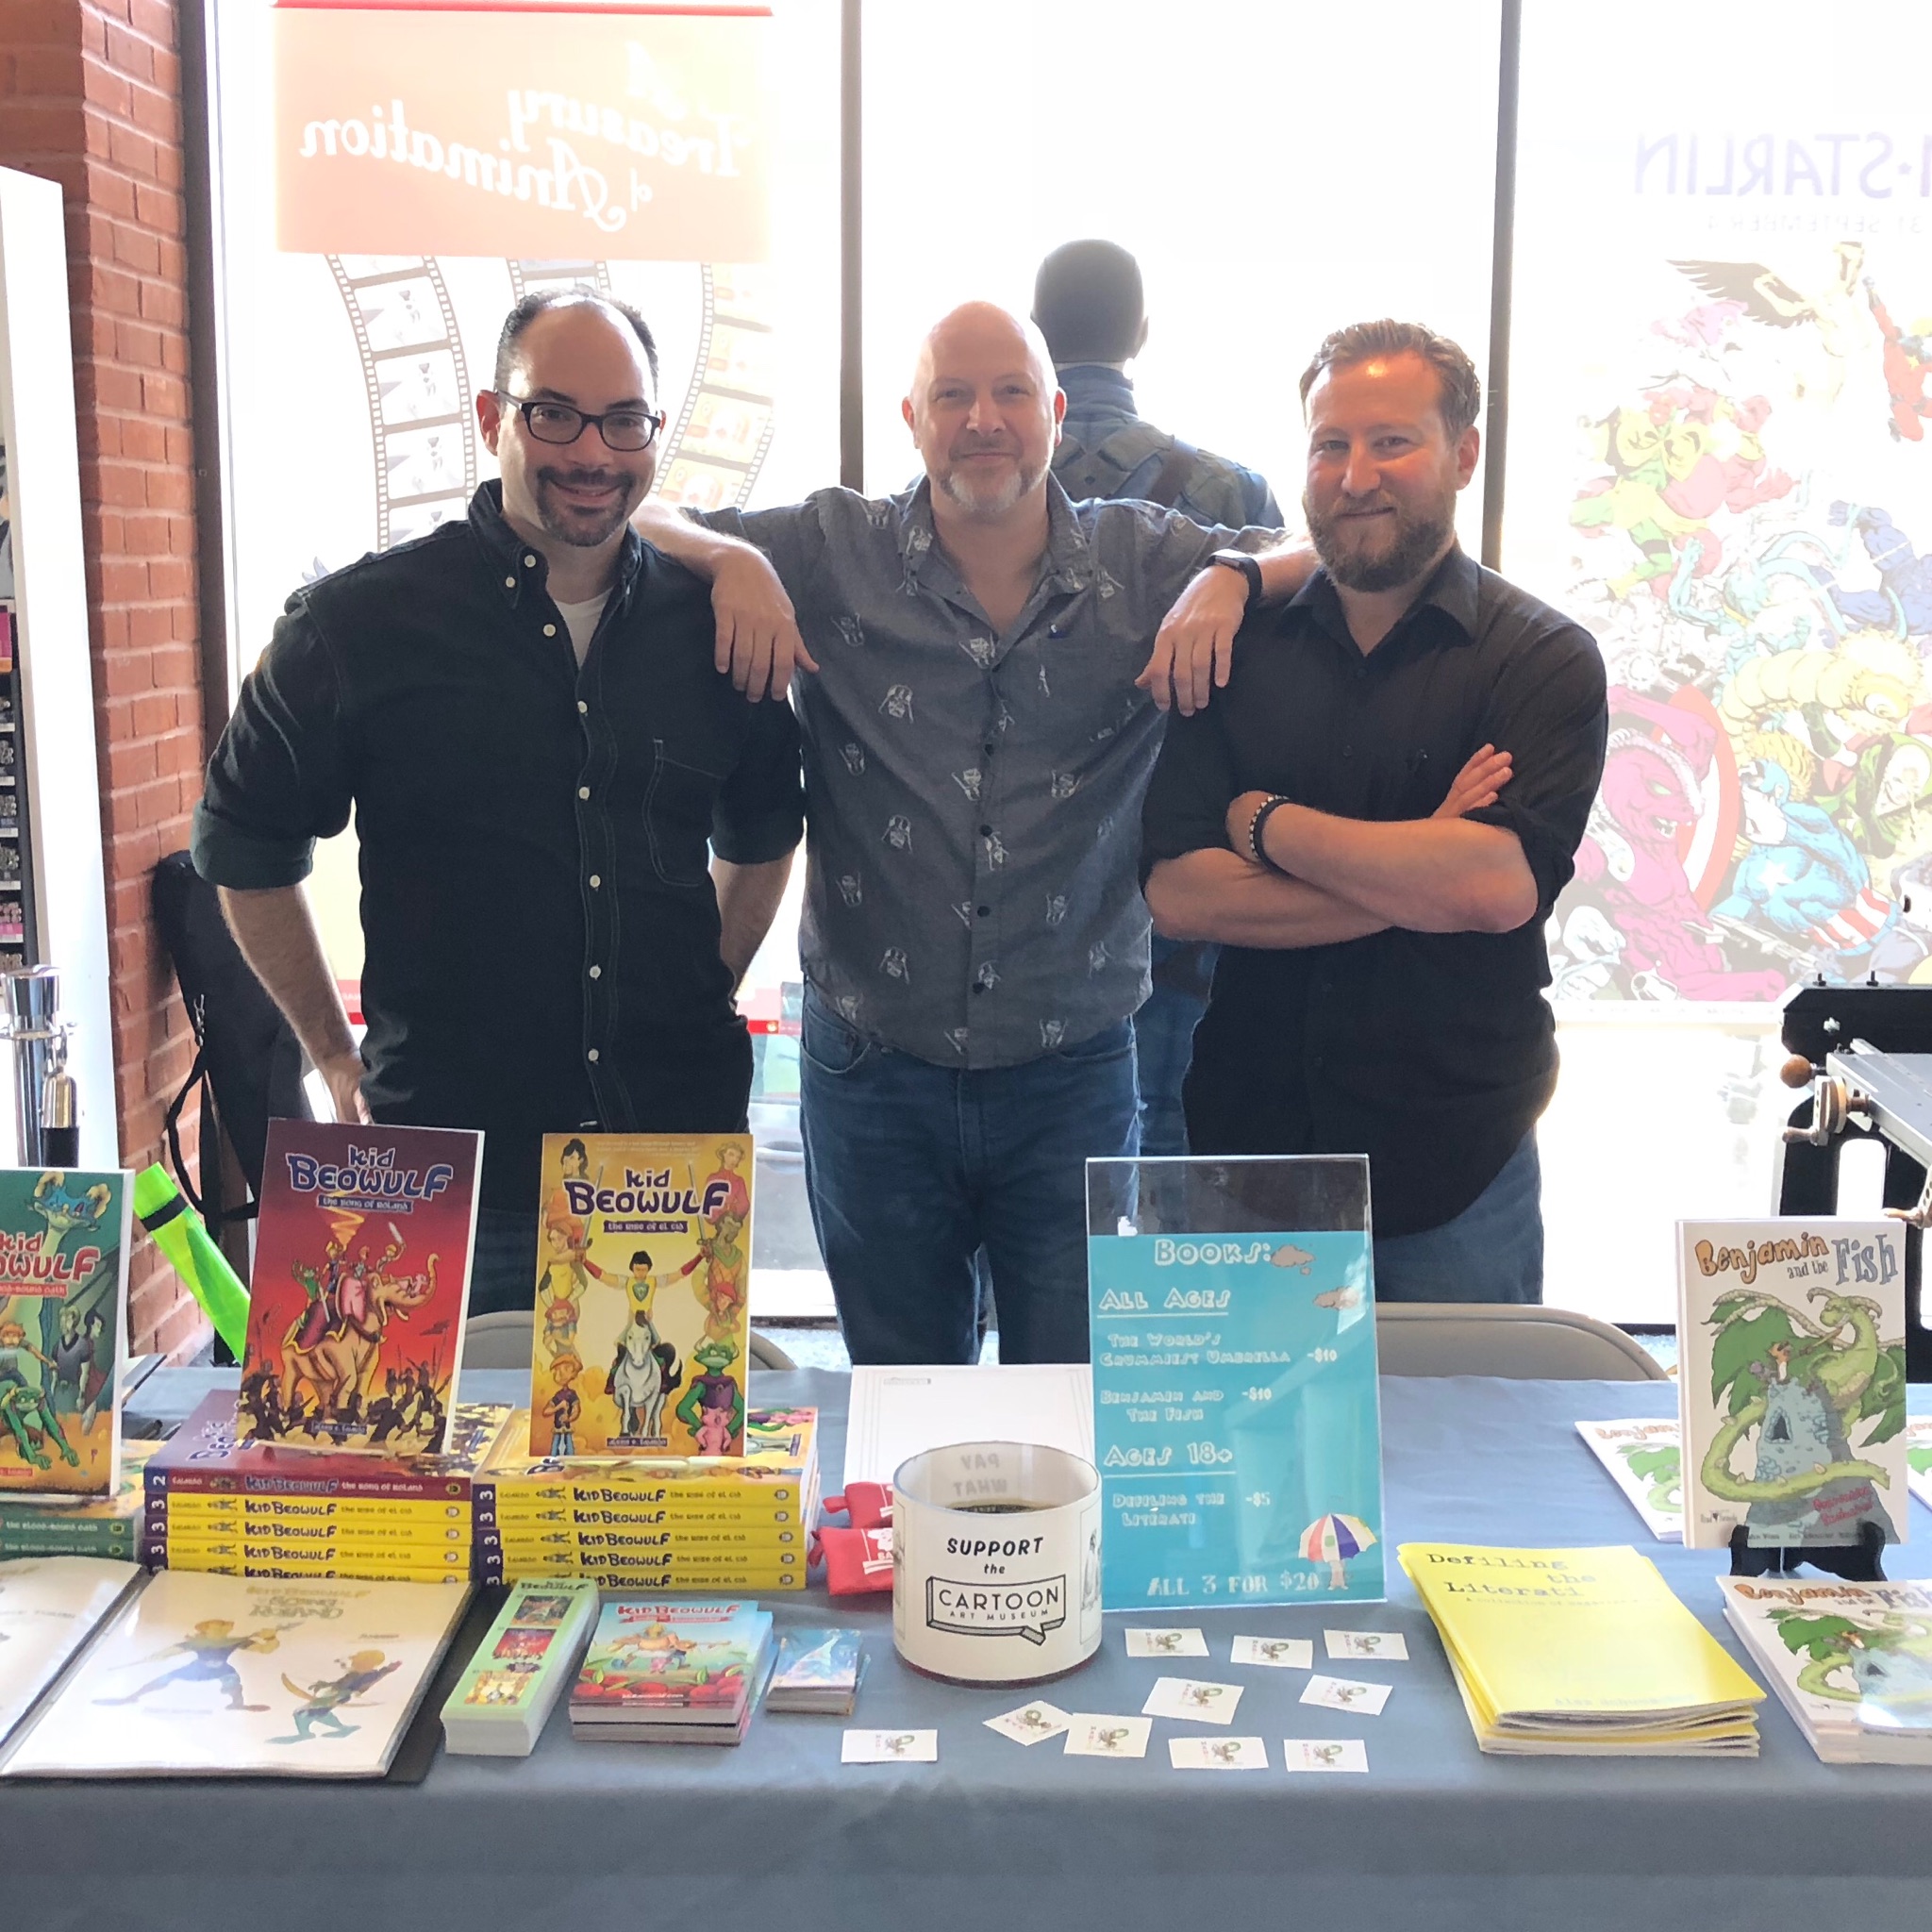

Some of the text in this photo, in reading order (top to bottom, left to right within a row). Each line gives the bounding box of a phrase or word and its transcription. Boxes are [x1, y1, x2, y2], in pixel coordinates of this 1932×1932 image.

[286, 1152, 454, 1202] BEOWULF
[564, 1180, 730, 1216] BEOWULF
[1694, 1231, 1898, 1286] Benjamin and the Fish
[1187, 1441, 1233, 1465] 18+
[153, 1475, 166, 1486] 2
[479, 1491, 493, 1500] 3
[600, 1489, 666, 1502] BEOWULF
[152, 1499, 165, 1508] 3
[272, 1501, 337, 1515] BEOWULF
[479, 1512, 493, 1522] 3
[600, 1510, 666, 1524] BEOWULF
[152, 1523, 165, 1532] 3
[272, 1524, 337, 1538] BEOWULF
[484, 1535, 498, 1545] 3
[605, 1533, 671, 1546] BEOWULF
[946, 1536, 1043, 1557] SUPPORT
[151, 1545, 164, 1555] 3
[271, 1546, 336, 1560] BEOWULF
[487, 1556, 501, 1564] 3
[608, 1553, 673, 1566] BEOWULF
[984, 1563, 1006, 1574] the
[1426, 1552, 1570, 1572] Defiling
[607, 1574, 672, 1588] BEOWULF
[1147, 1571, 1320, 1596] ALL 3 FOR $20
[1547, 1574, 1597, 1585] the
[1443, 1582, 1586, 1597] Literati
[939, 1586, 1058, 1610] CARTOON
[950, 1608, 1048, 1621] ART MUSEUM
